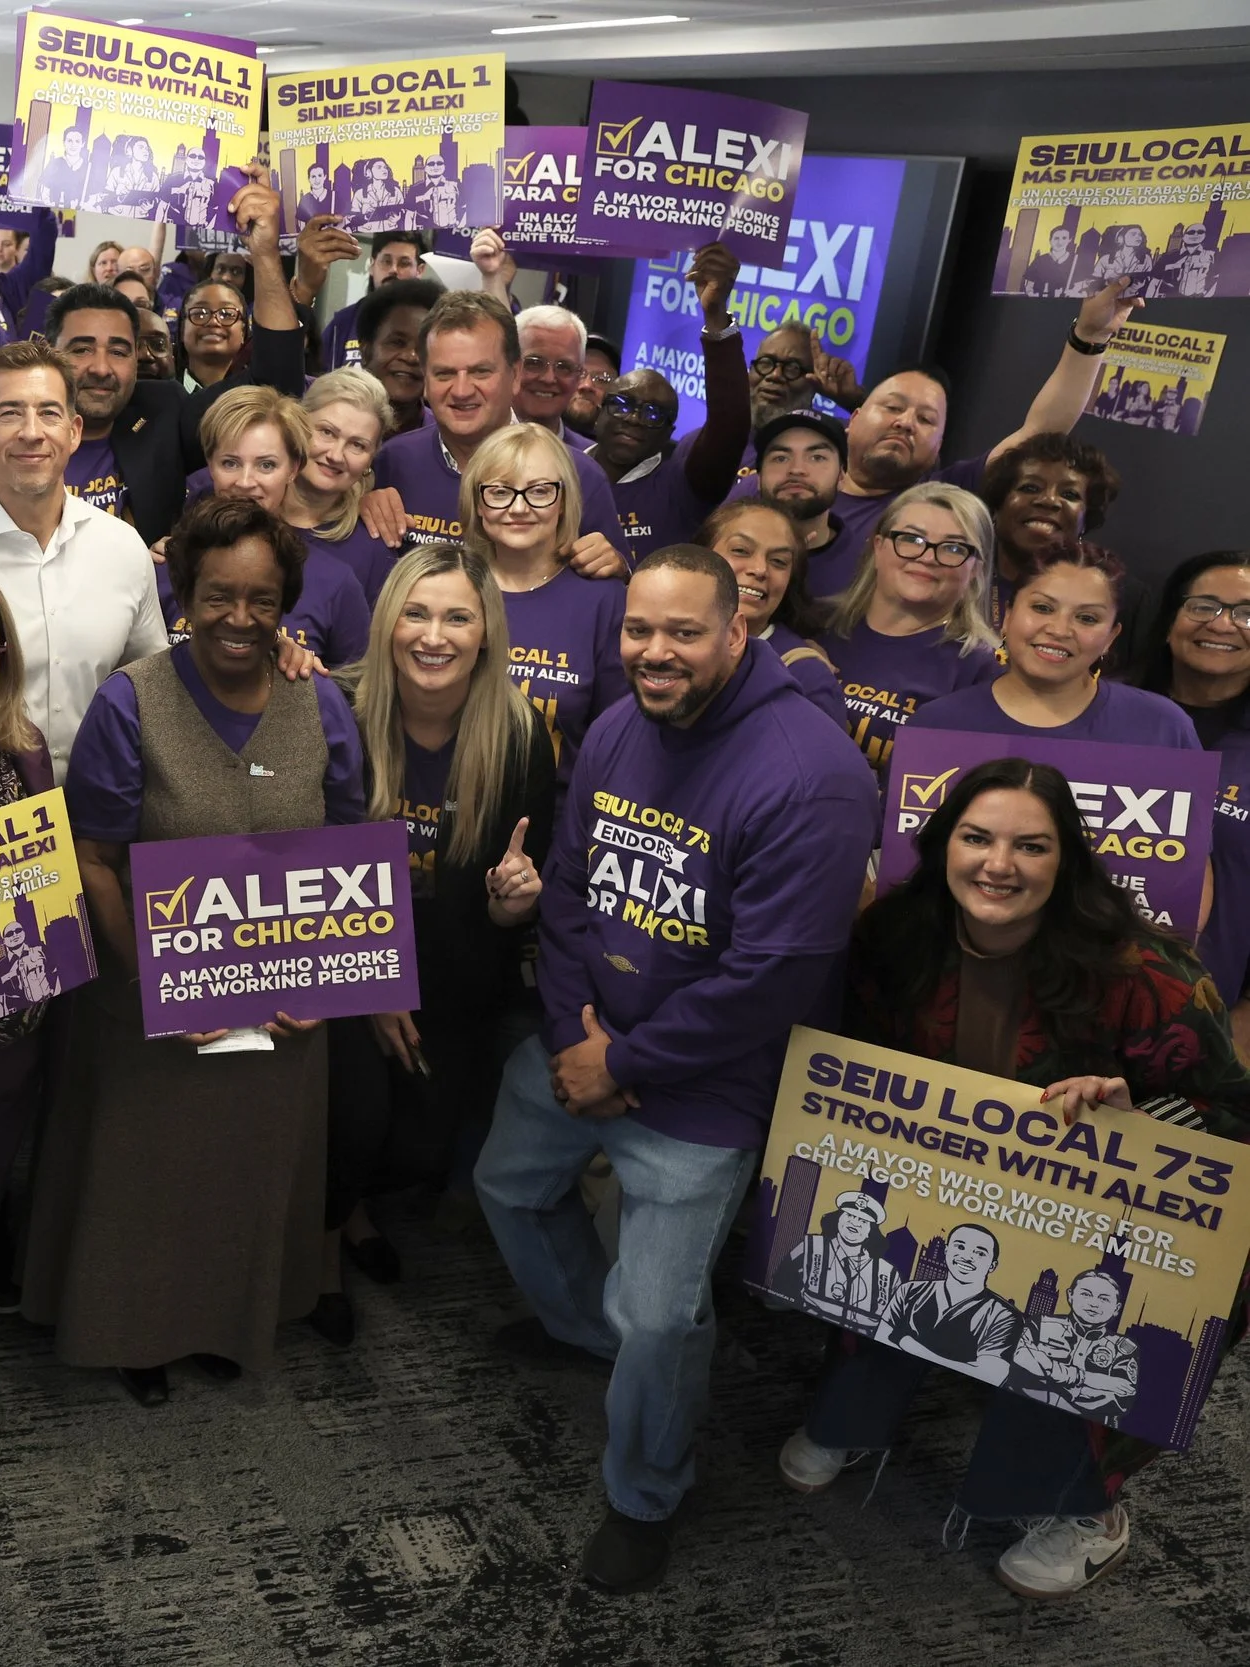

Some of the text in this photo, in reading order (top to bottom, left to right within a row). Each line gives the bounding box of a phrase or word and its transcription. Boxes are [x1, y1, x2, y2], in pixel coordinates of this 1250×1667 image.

[38, 26, 231, 85] SEIU LOCAL
[35, 55, 249, 109] STRONGER WITH ALEXI
[278, 68, 466, 106] SEIU LOCAL
[63, 83, 235, 123] MAYOR WHO WORKS FOR
[120, 101, 245, 136] WORKING FAMILIES
[298, 94, 464, 123] SILNIEJSI ALEXI
[374, 123, 482, 140] RODZIN CHICAGO
[634, 121, 792, 181] ALEXI
[1029, 142, 1118, 166] SEIU
[594, 158, 657, 182] FOR
[665, 164, 784, 203] CHICAGO
[1070, 164, 1207, 183] FUERTE CON
[503, 186, 556, 202] PARA
[1044, 182, 1242, 198] ALCALDE TRABAJA PARA
[520, 212, 539, 222] UN
[593, 203, 630, 219] FOR
[635, 207, 722, 229] WORKING
[726, 218, 778, 242] PEOPLE
[613, 192, 781, 229] MAYOR WHO WORKS
[502, 232, 547, 242] GENTE
[636, 342, 648, 361] A
[1146, 331, 1215, 353] LOCAL 1
[1154, 348, 1211, 364] WITH ALEXI
[537, 665, 579, 685] ALEXI
[556, 653, 568, 668] 1
[844, 697, 879, 716] WITH
[903, 698, 918, 714] 1
[1223, 785, 1239, 801] 1
[685, 825, 711, 854] 73
[13, 864, 44, 885] FOR
[193, 862, 394, 925] ALEXI
[151, 910, 395, 958] FOR CHICAGO
[622, 898, 710, 946] MAYOR
[180, 949, 400, 985] MAYOR WHO WORKS
[160, 964, 401, 1004] FOR WORKING PEOPLE
[806, 1052, 1235, 1196] SEIU LOCAL 73
[801, 1091, 1224, 1231] STRONGER WITH ALEXI
[840, 1139, 1174, 1252] MAYOR WHO WORKS FOR
[938, 1188, 1198, 1278] WORKING FAMILIES
